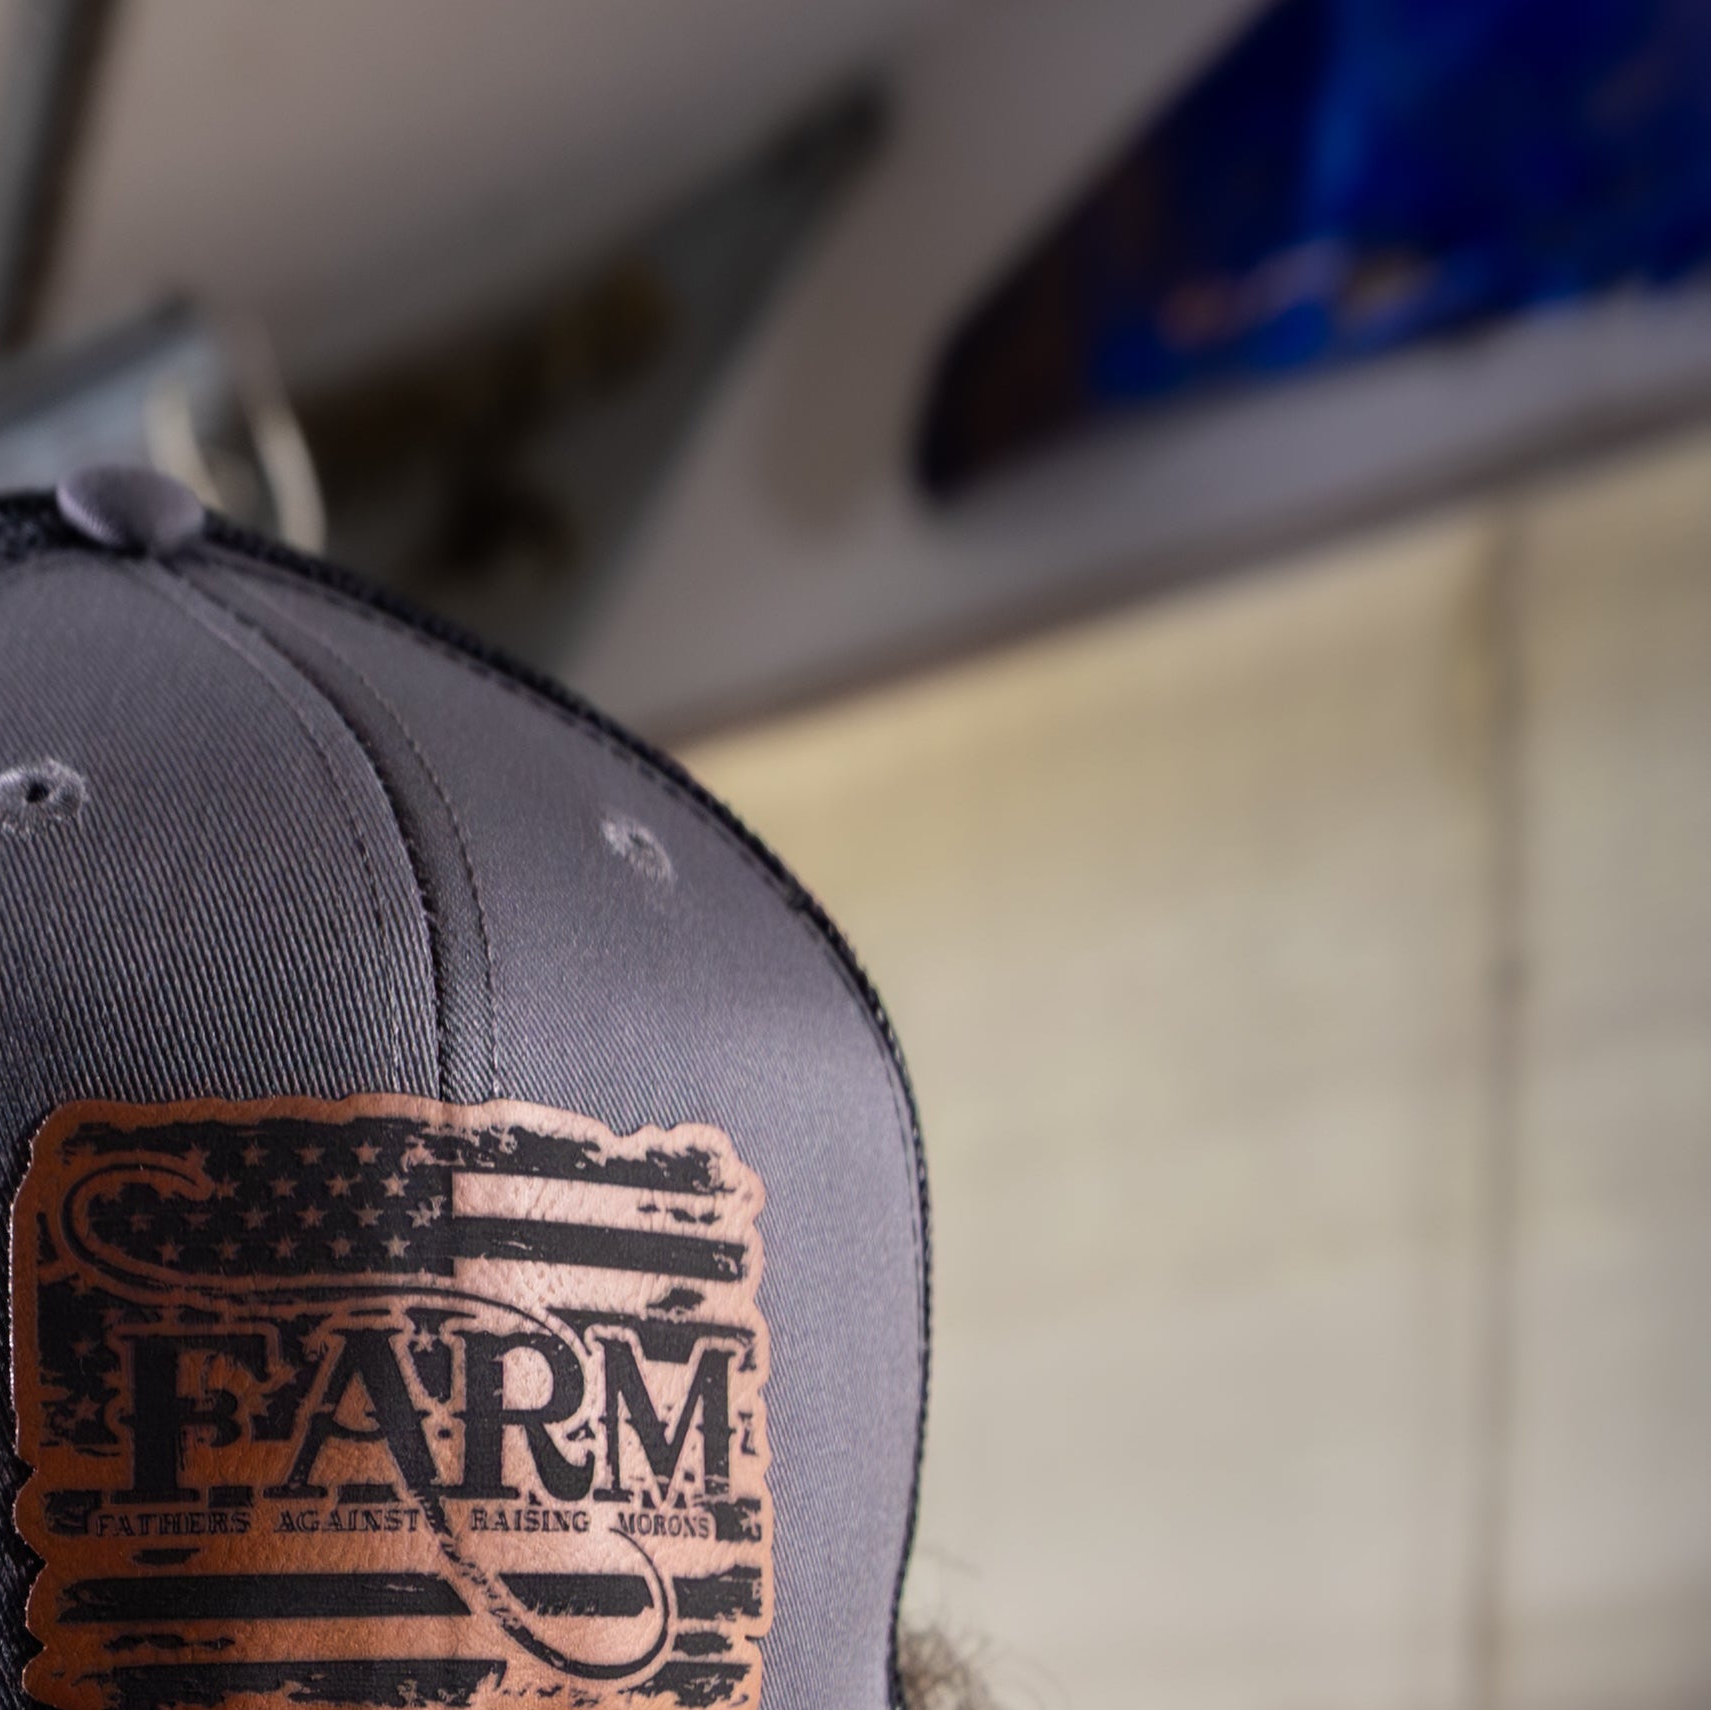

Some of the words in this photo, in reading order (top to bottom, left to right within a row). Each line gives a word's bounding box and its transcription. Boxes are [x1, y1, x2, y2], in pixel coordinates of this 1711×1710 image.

[110, 1327, 735, 1508] FARM
[95, 1510, 251, 1537] FATHERS
[273, 1508, 420, 1533] AGAINST
[470, 1508, 591, 1533] RAISING
[617, 1511, 711, 1540] MORONS
